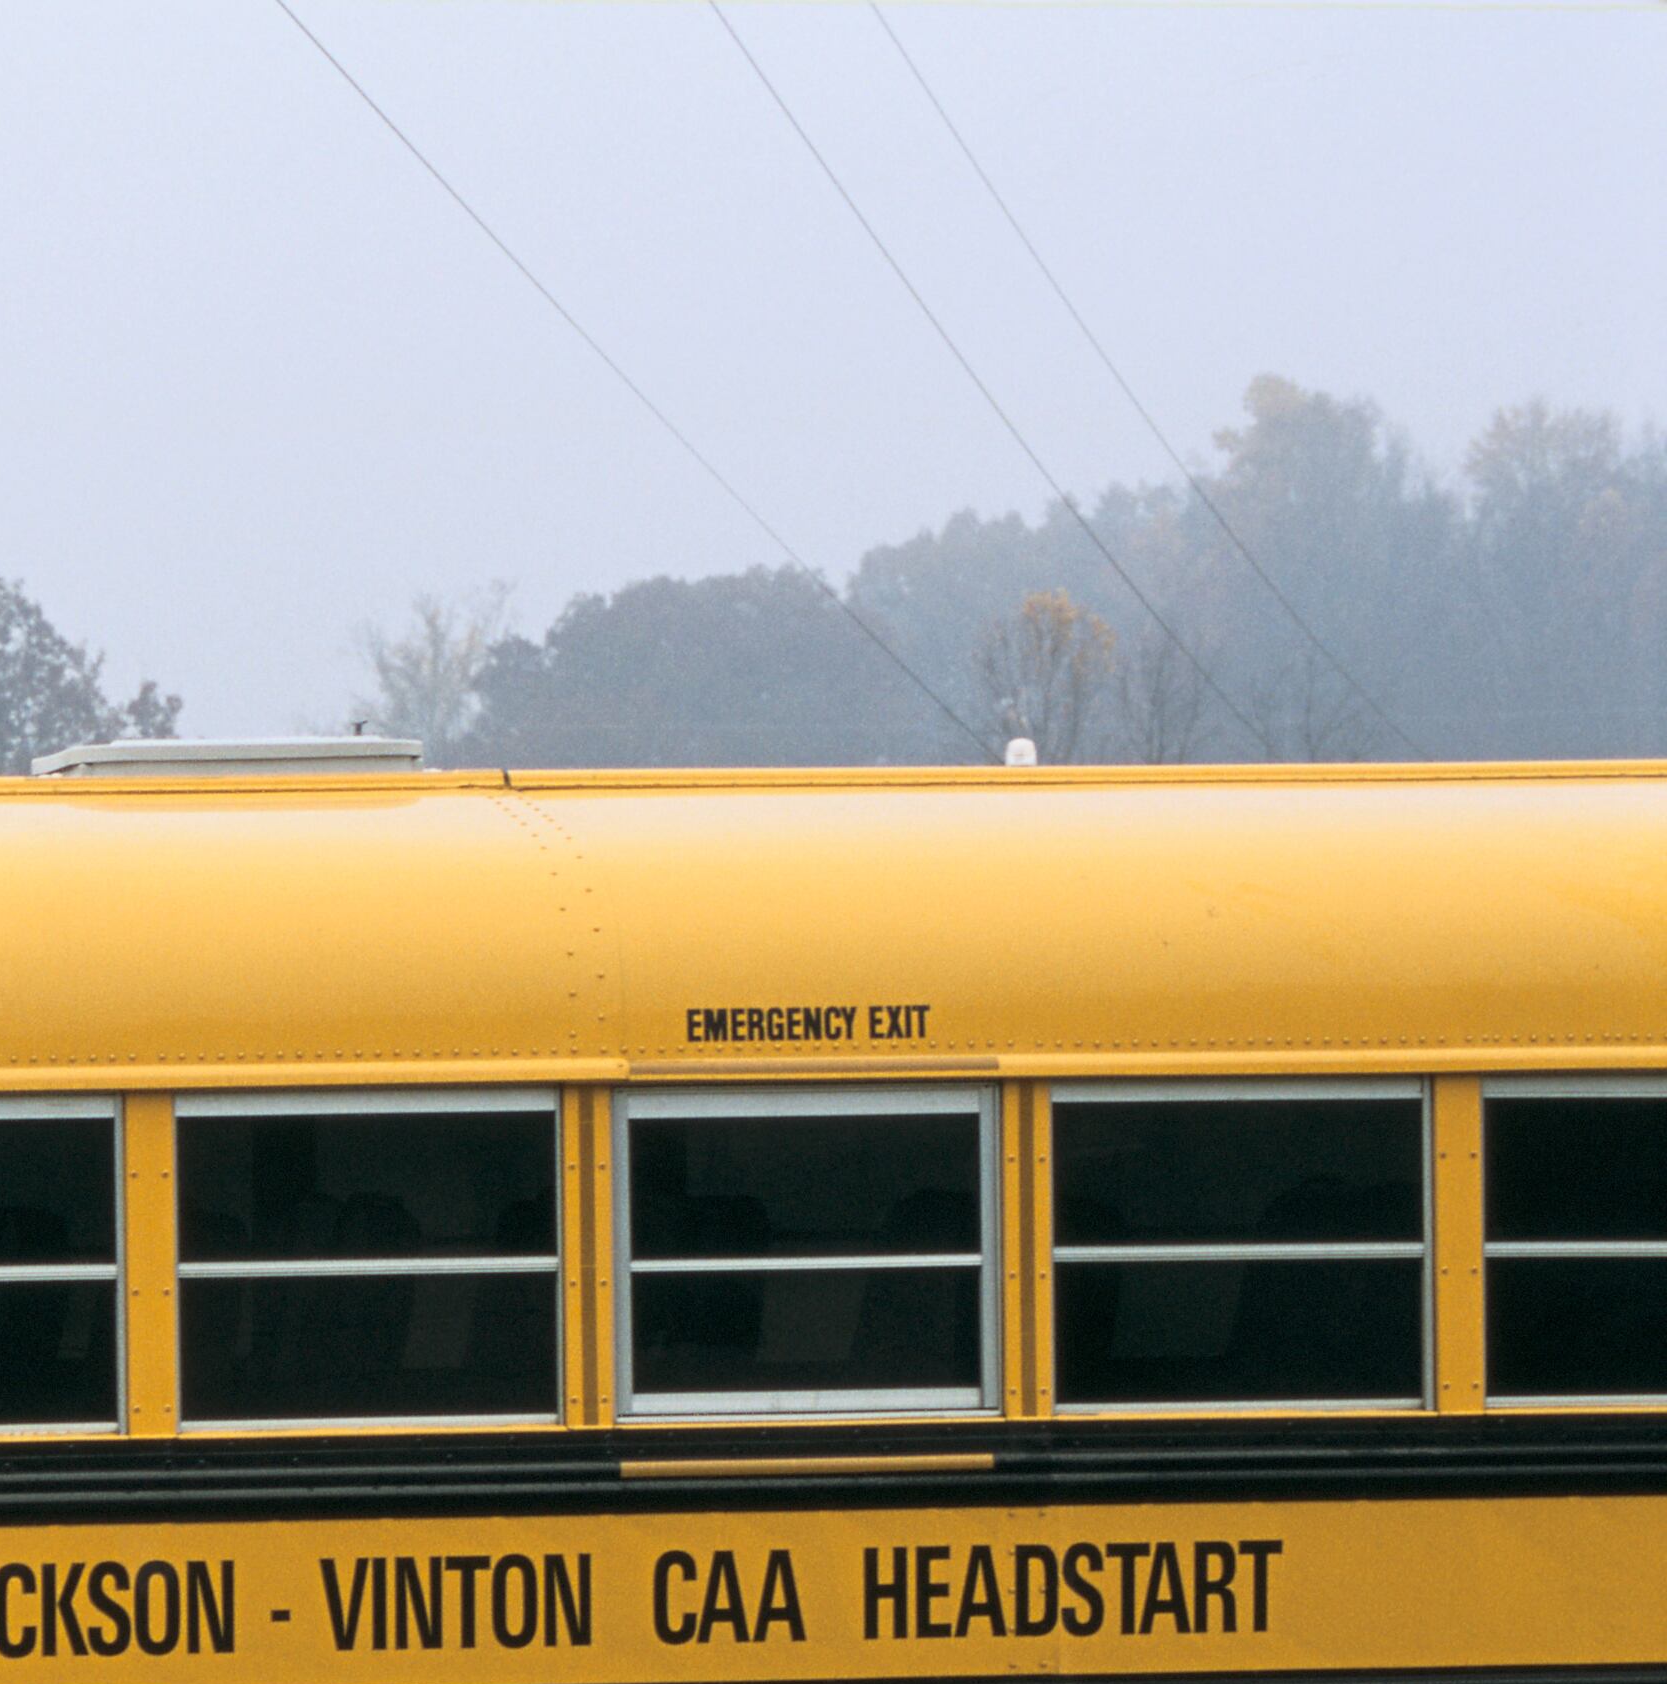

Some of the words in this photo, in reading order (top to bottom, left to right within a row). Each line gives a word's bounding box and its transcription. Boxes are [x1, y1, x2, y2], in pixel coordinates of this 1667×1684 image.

[686, 1006, 857, 1042] EMERGENCY
[868, 1004, 930, 1039] EXIT
[319, 1553, 592, 1651] VINTON
[652, 1549, 807, 1645] CAA
[863, 1539, 1283, 1640] HEADSTART
